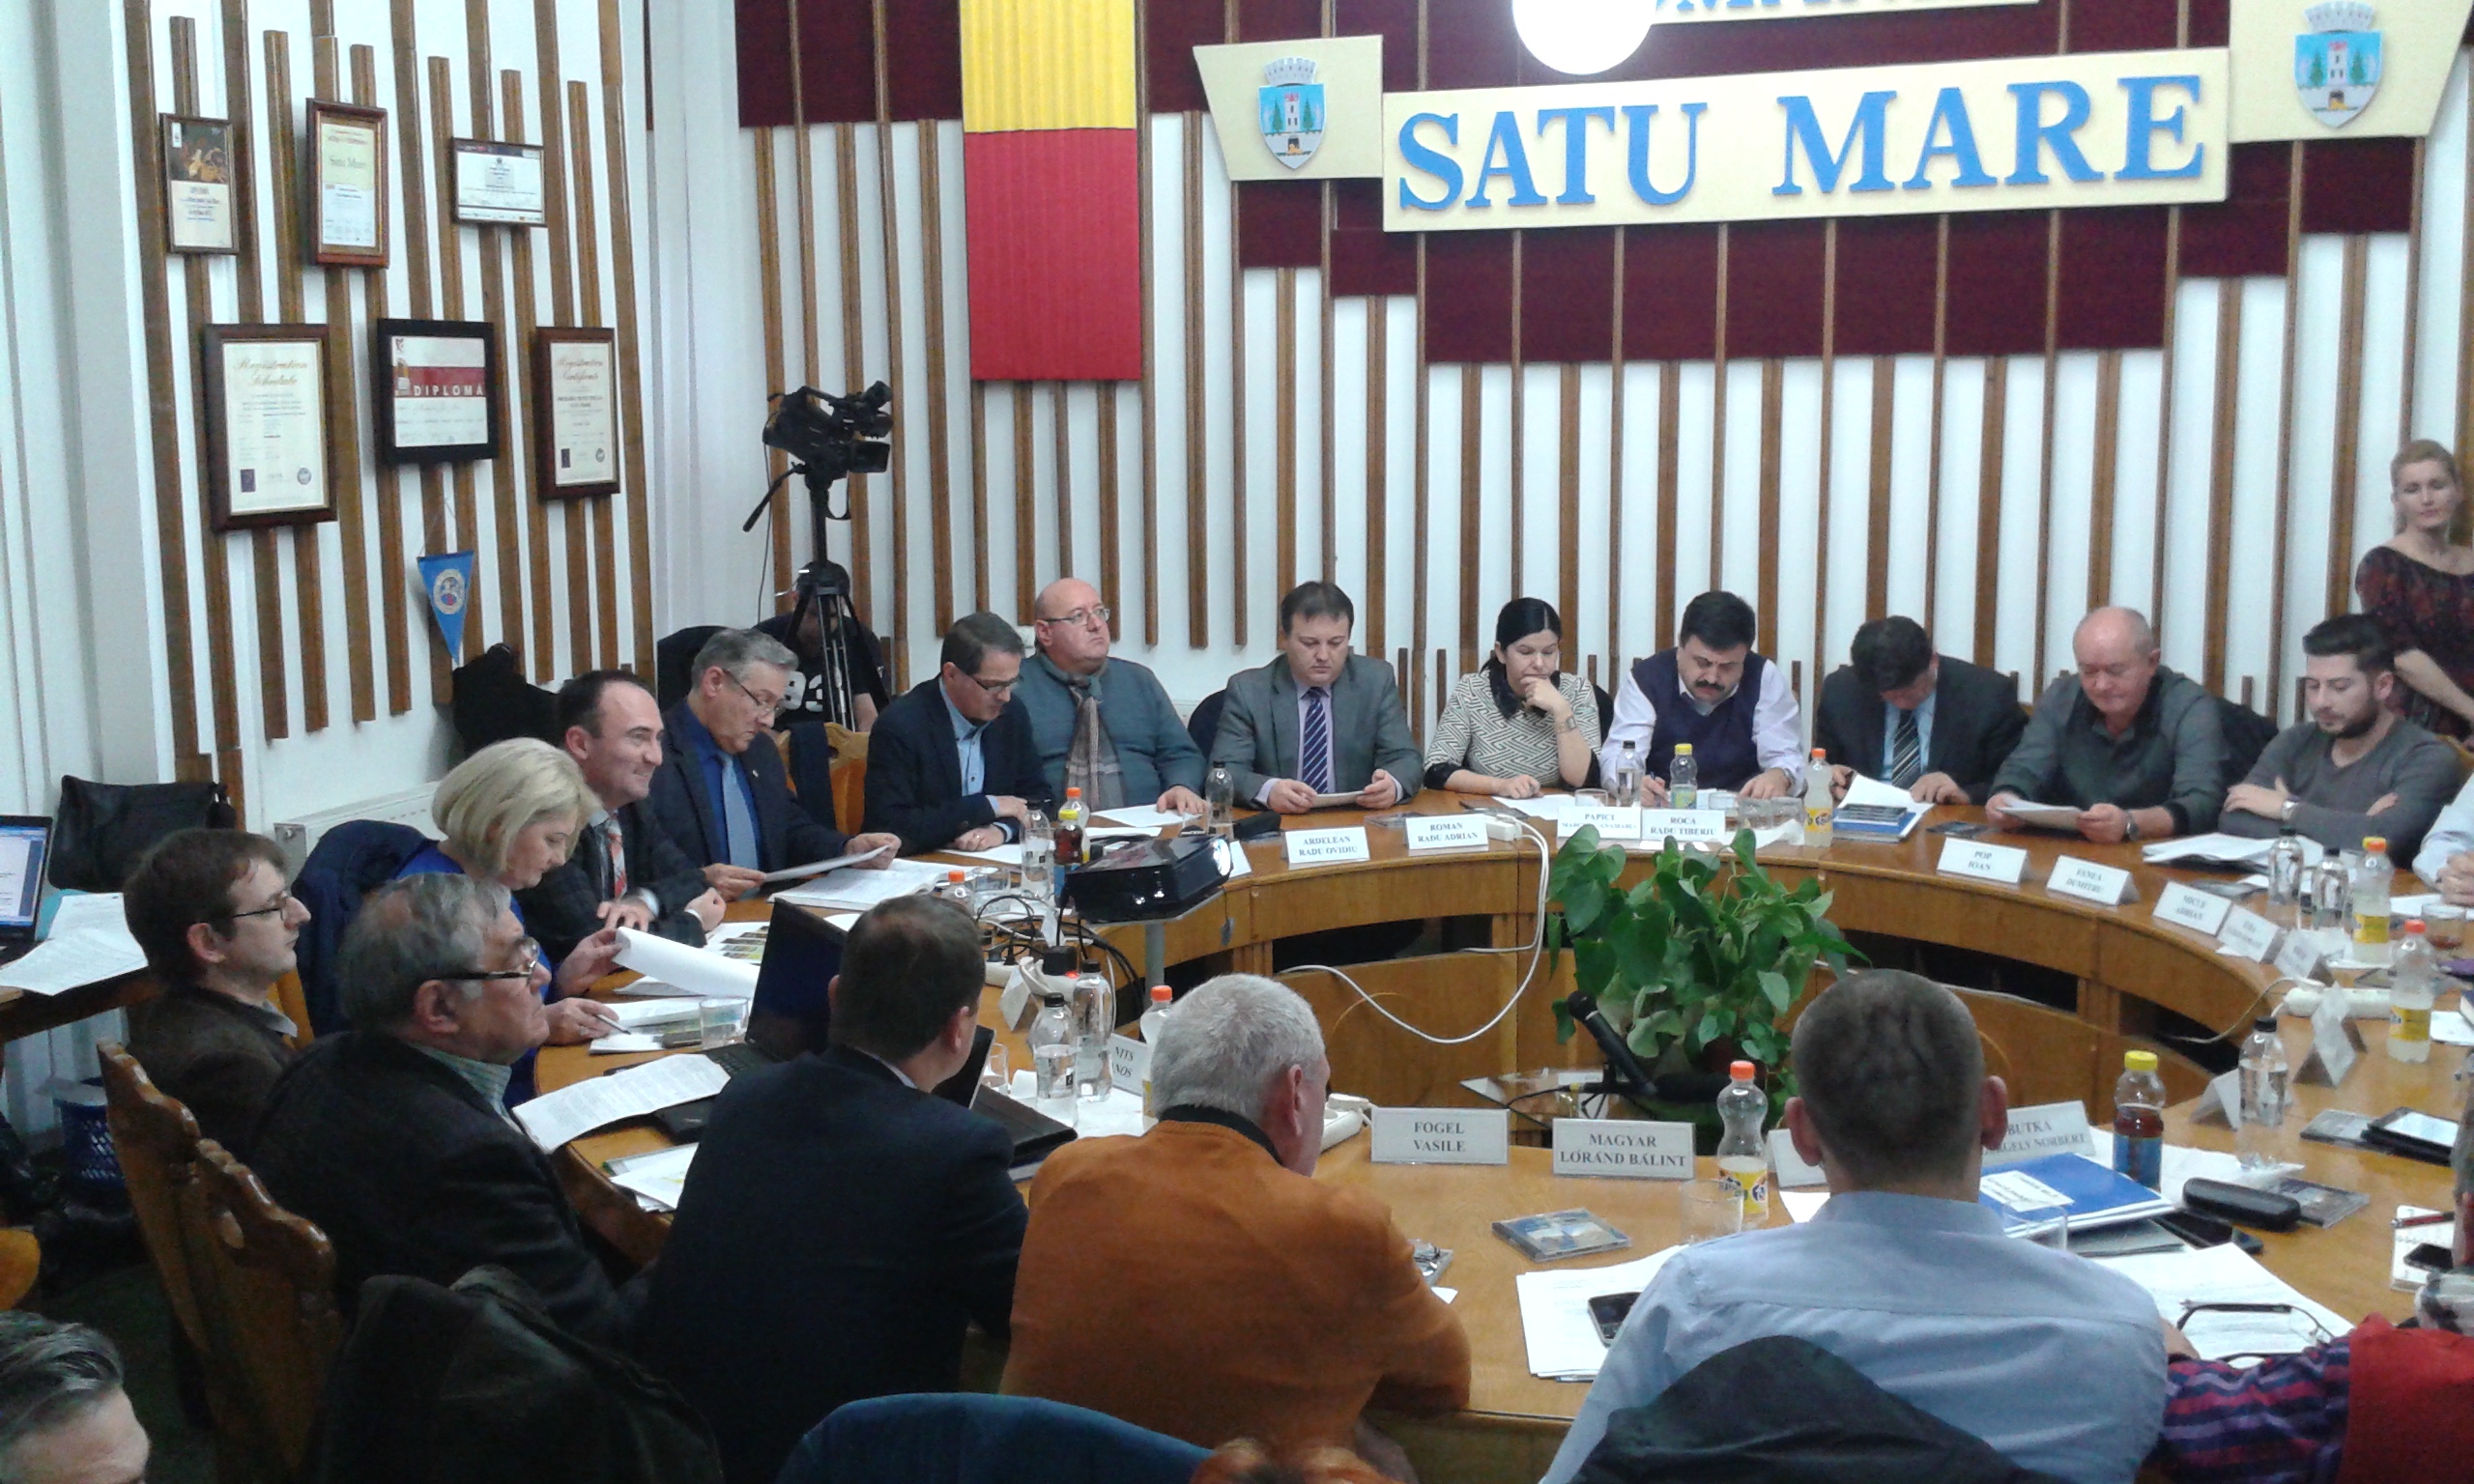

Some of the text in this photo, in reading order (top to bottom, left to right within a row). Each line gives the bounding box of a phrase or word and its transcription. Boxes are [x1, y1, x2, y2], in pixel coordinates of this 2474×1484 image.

[1398, 74, 2204, 211] SATU MARE
[413, 383, 484, 397] DIPLOMA
[1429, 822, 1463, 832] ROMAN
[1670, 816, 1696, 825] ROCA
[1303, 836, 1351, 845] ARDELEAN
[1417, 832, 1479, 842] RADU ADRIAN
[1298, 845, 1358, 857] RADU OVIDIU
[1414, 1122, 1466, 1134] FOGEL
[2008, 1121, 2052, 1135] BUTKA
[1413, 1139, 1466, 1153] VASILE
[1589, 1133, 1657, 1148] MAGYAR
[1628, 1153, 1686, 1167] BÁLINT
